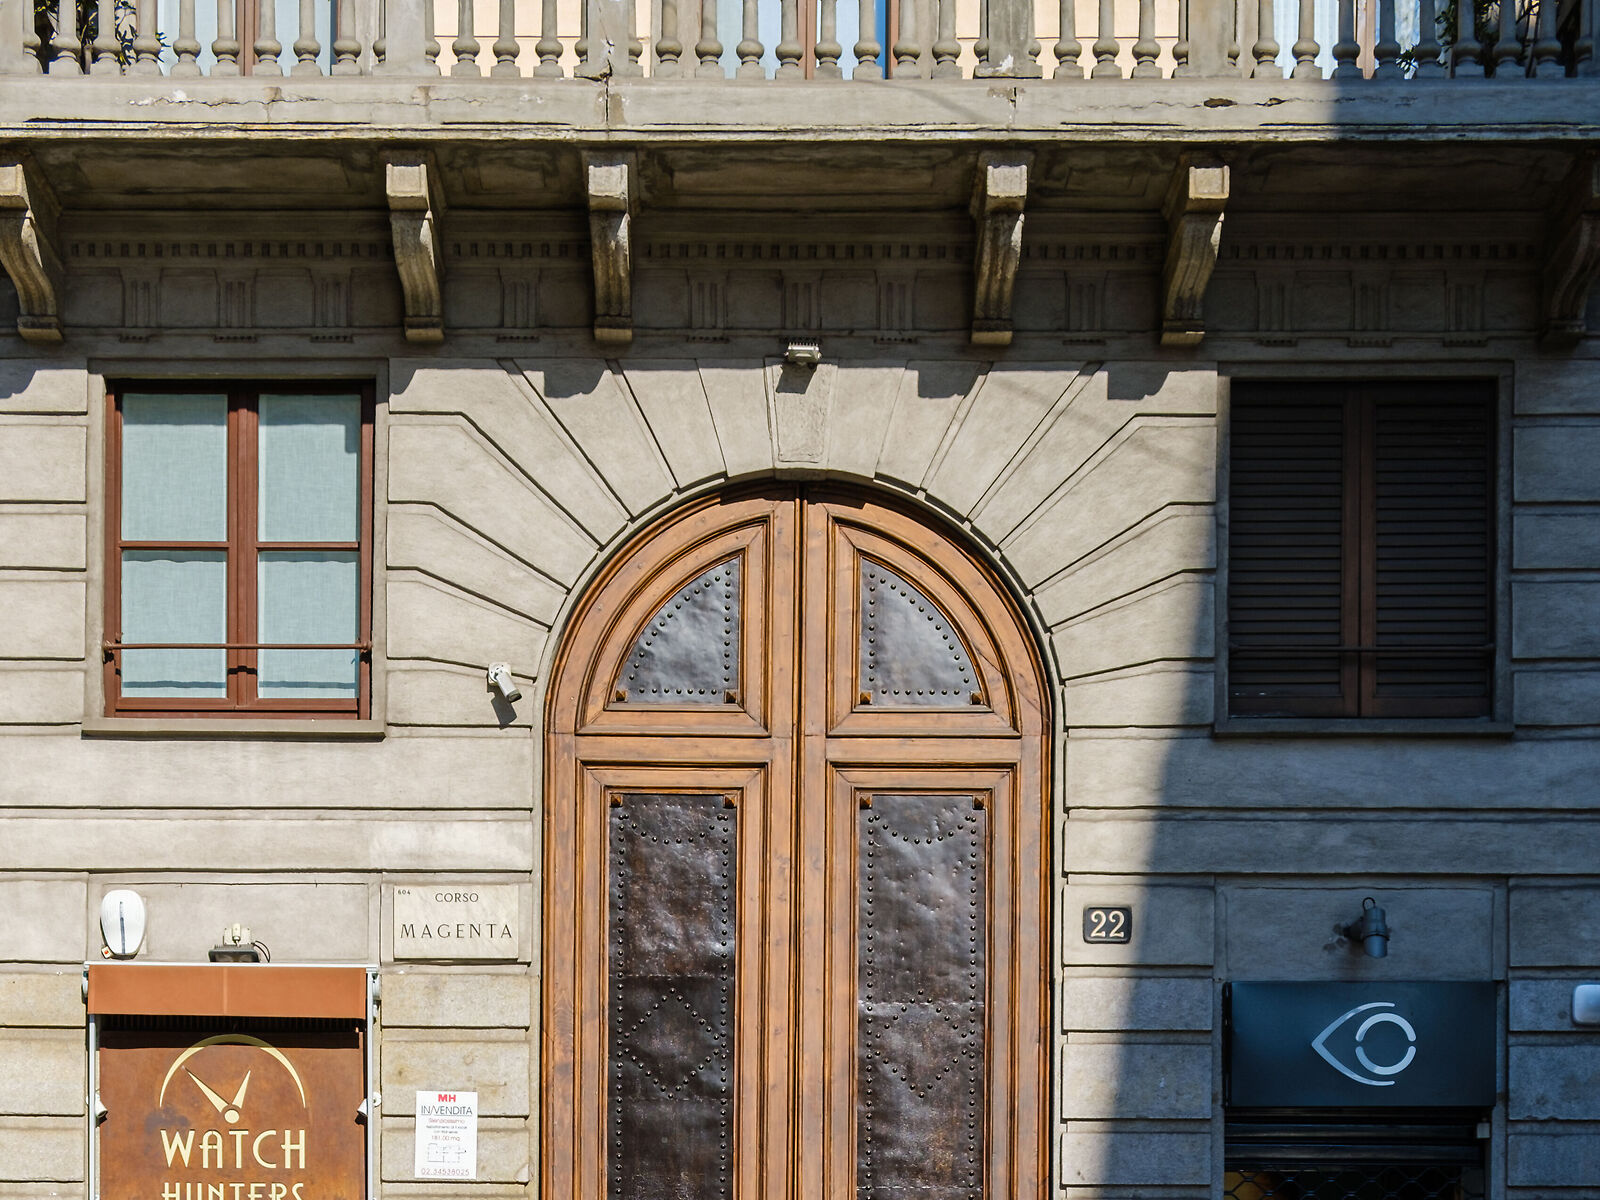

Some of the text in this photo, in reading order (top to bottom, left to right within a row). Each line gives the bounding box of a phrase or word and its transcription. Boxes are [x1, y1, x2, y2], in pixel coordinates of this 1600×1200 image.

[435, 893, 479, 902] CORSO
[400, 924, 512, 938] MAGENTA
[1091, 910, 1125, 938] 22
[438, 1094, 456, 1102] MH
[160, 1129, 305, 1168] WATCH
